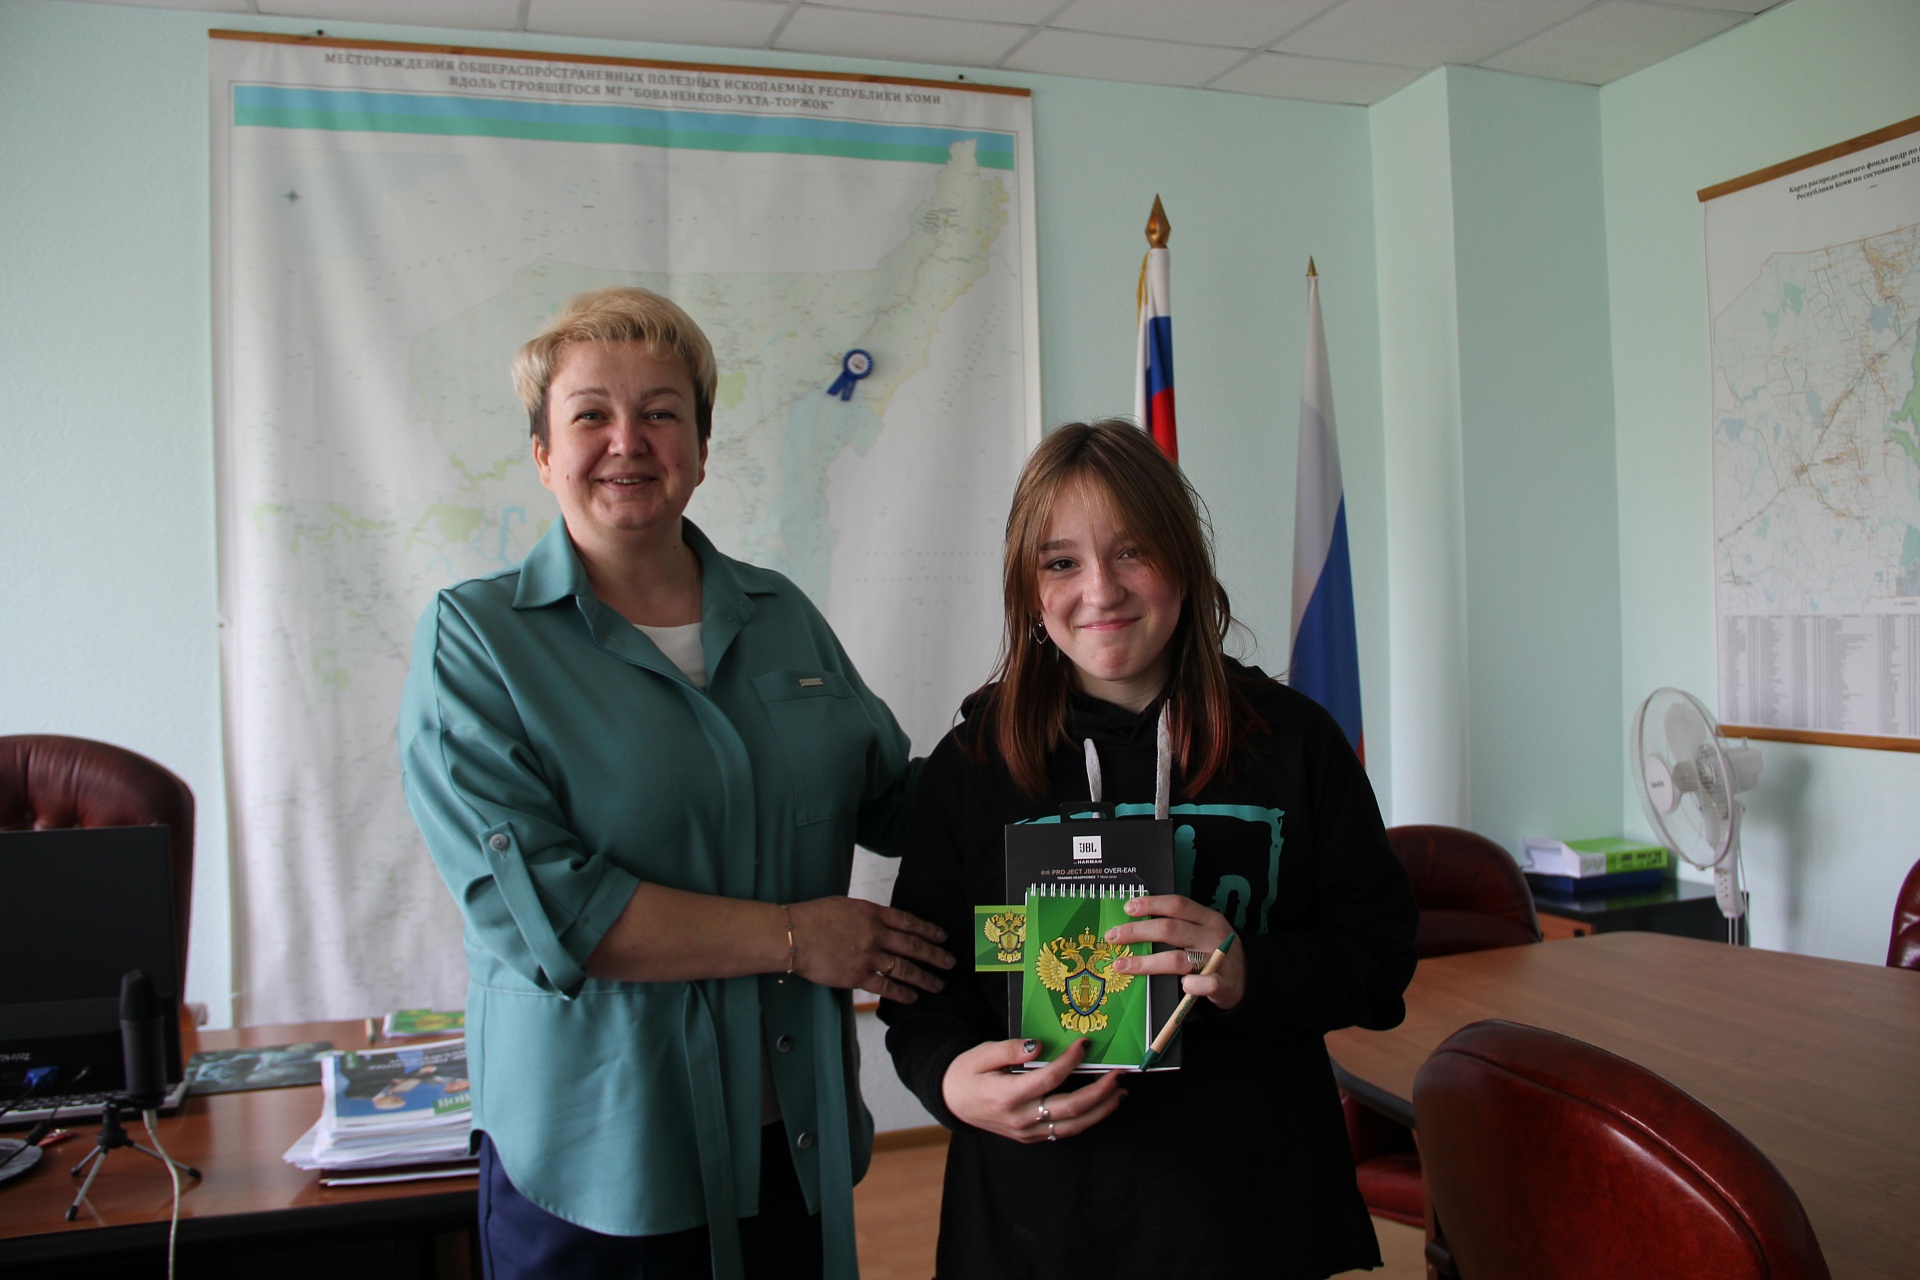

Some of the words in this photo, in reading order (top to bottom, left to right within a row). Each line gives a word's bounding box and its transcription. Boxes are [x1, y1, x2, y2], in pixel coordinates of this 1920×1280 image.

[325, 53, 454, 71] МЕСТОРОЖДЕНИЯ
[458, 61, 644, 84] ОБЩЕРАСПРОСТРАНЕННЫХ
[648, 73, 720, 89] ПОЛЕЗНЫХ
[724, 79, 815, 95] ИСКОПАЕМЫХ
[819, 86, 902, 103] РЕСПУБЛИКИ
[905, 93, 941, 105] КОМИ
[449, 75, 496, 89] ВДОЛЬ
[500, 76, 601, 95] СТРОЯЩЕГОСЯ
[605, 85, 624, 97] МГ
[1789, 182, 1808, 193] Карта
[1866, 157, 1889, 170] фонда
[1796, 185, 1834, 200] Республики
[1835, 178, 1852, 189] Коми
[1079, 842, 1097, 853] JBL
